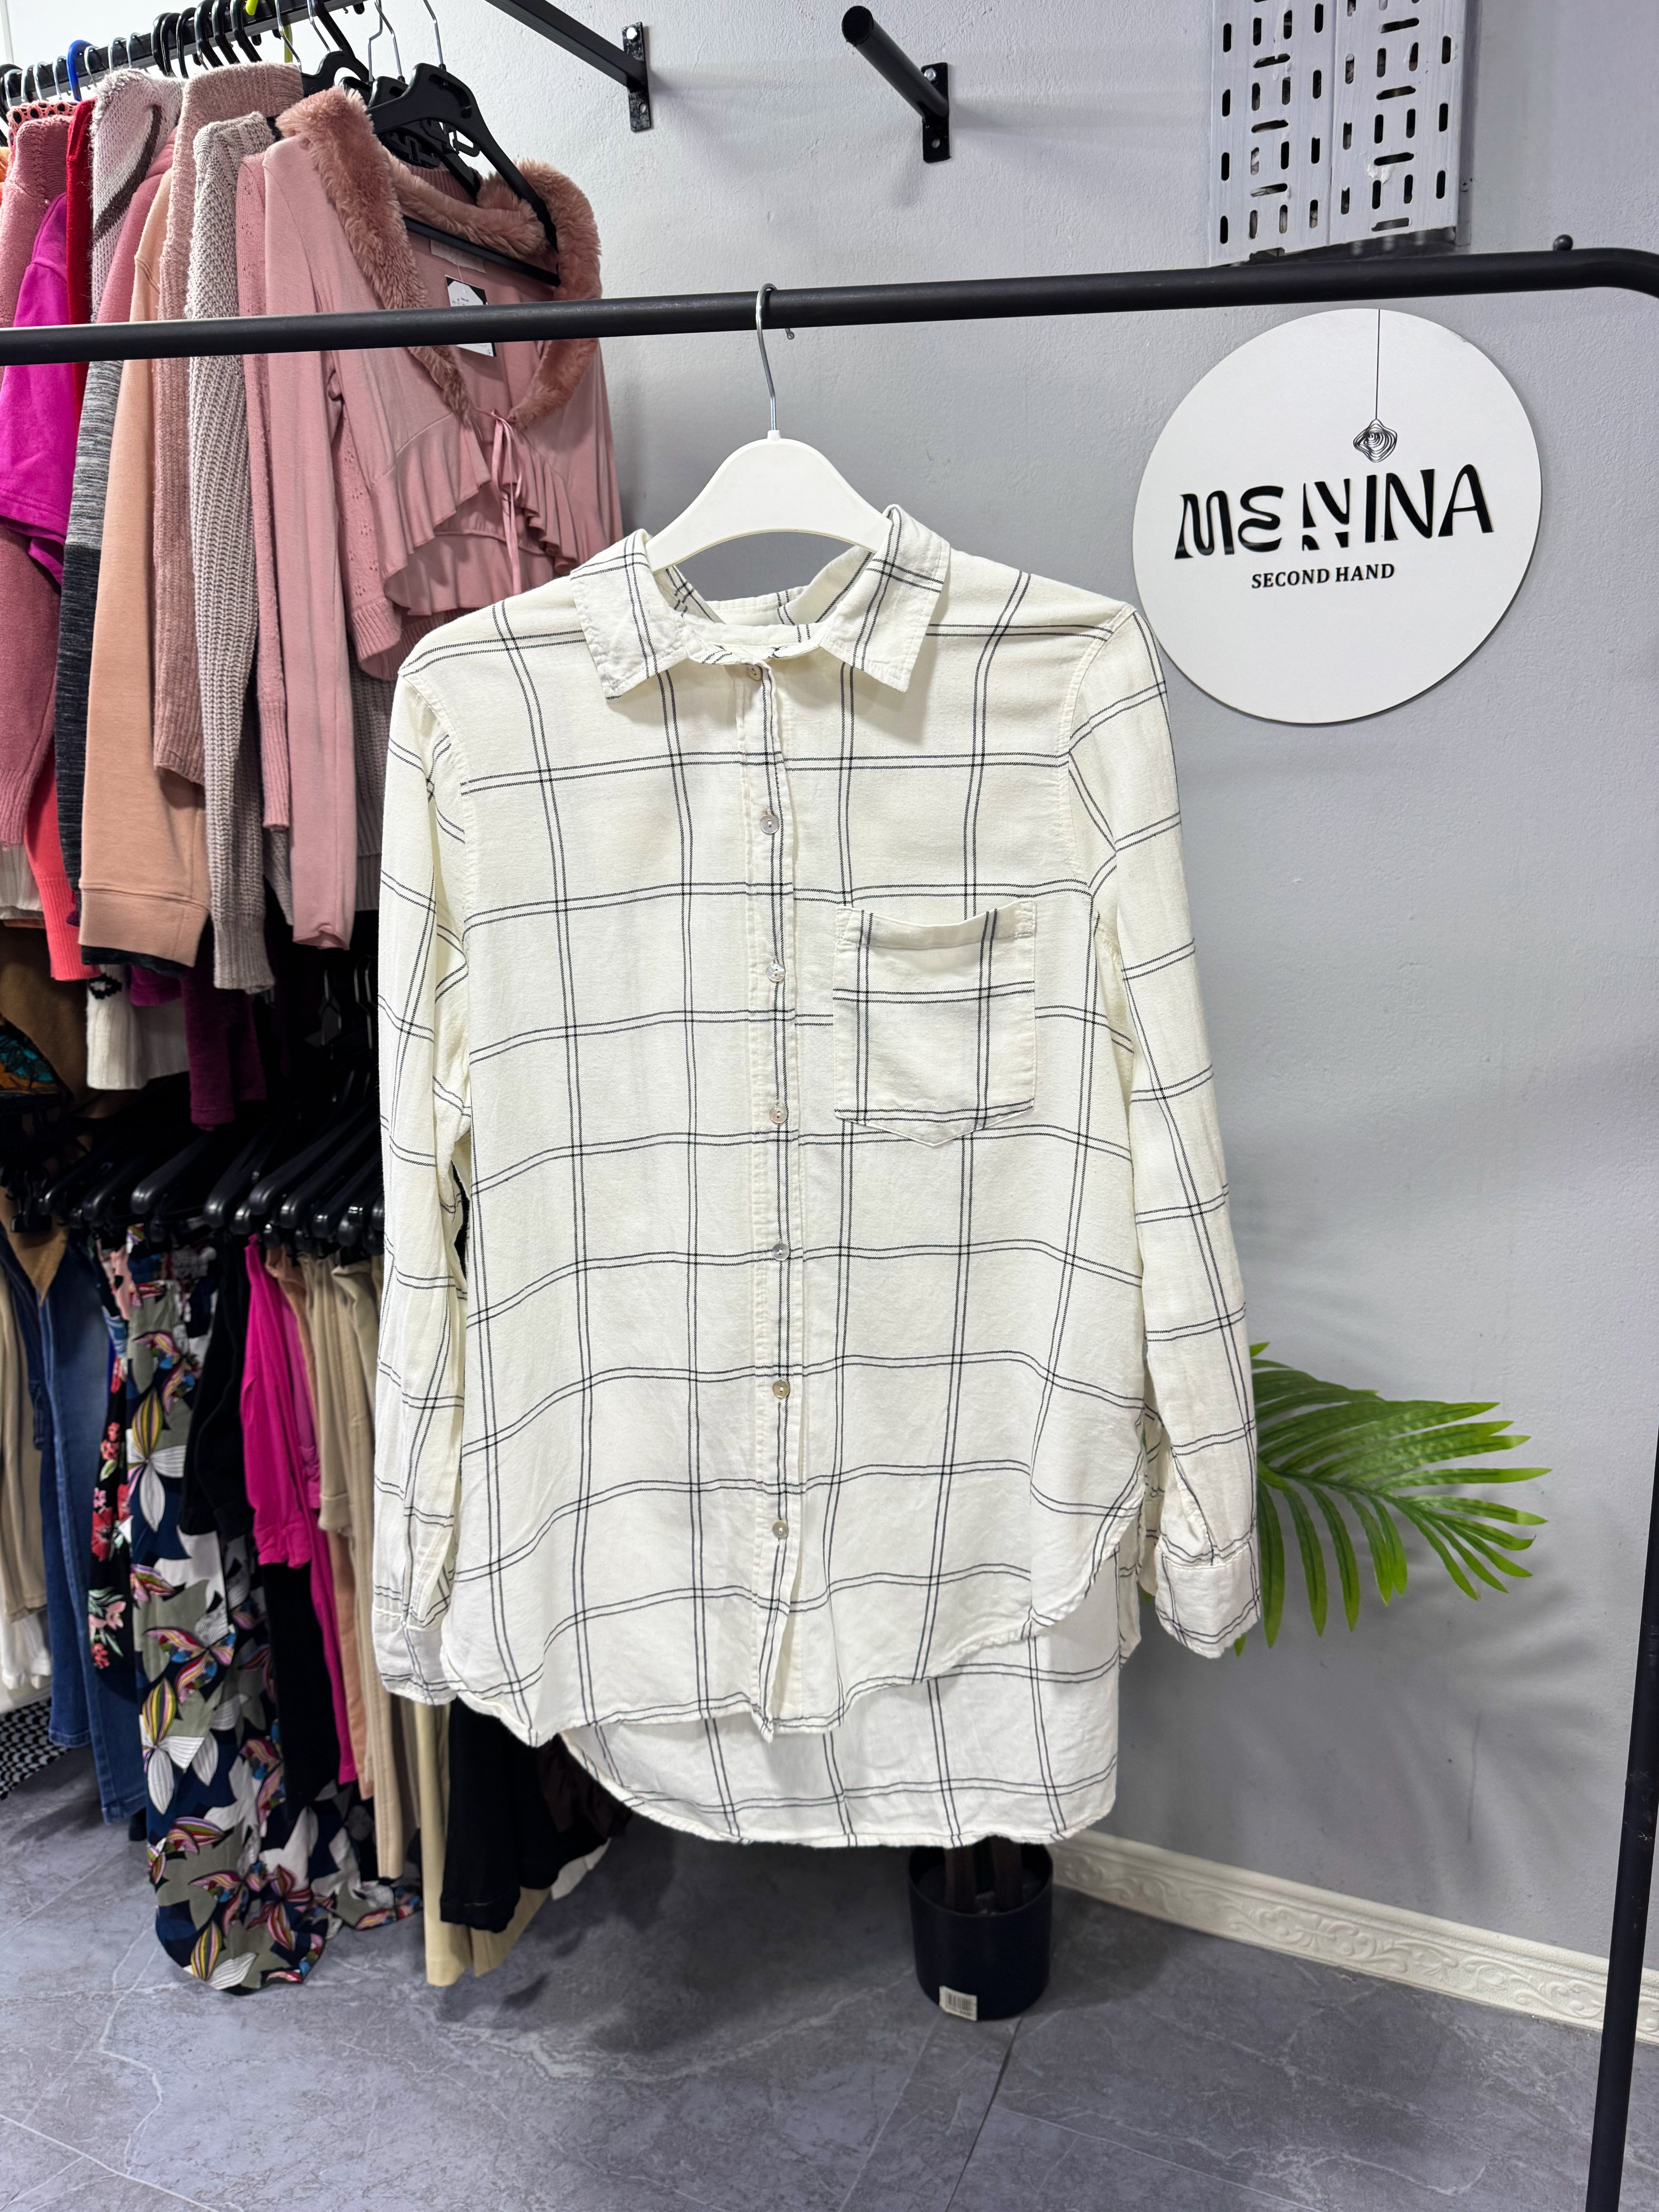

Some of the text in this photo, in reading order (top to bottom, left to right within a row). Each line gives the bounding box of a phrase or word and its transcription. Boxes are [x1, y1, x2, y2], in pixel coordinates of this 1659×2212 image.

[1174, 464, 1494, 559] MENINA
[1251, 563, 1395, 589] SECOND HAND
